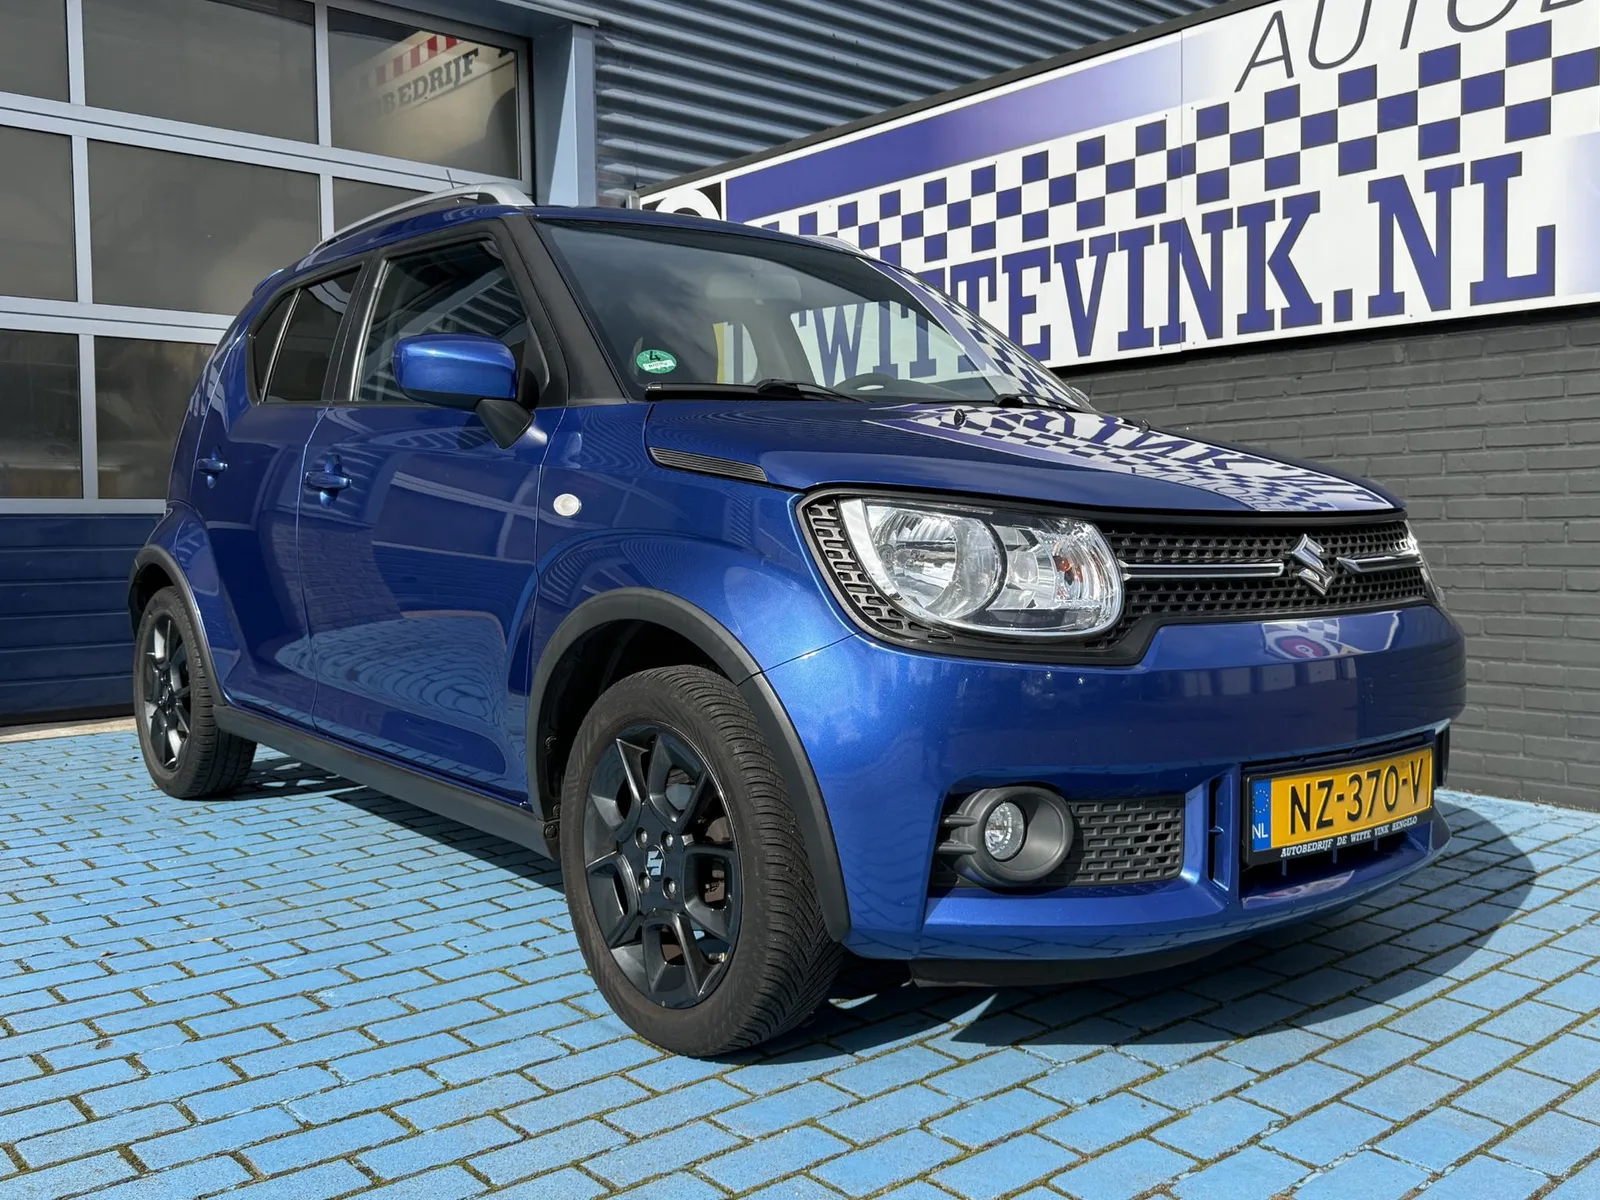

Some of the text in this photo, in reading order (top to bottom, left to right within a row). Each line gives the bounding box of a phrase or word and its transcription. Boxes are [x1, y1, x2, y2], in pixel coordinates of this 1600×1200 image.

[1289, 758, 1424, 835] NZ-370-V
[1252, 823, 1268, 839] NL
[1280, 815, 1418, 857] AUTOBEDRIJF DE WITTE VINK HENGELO
